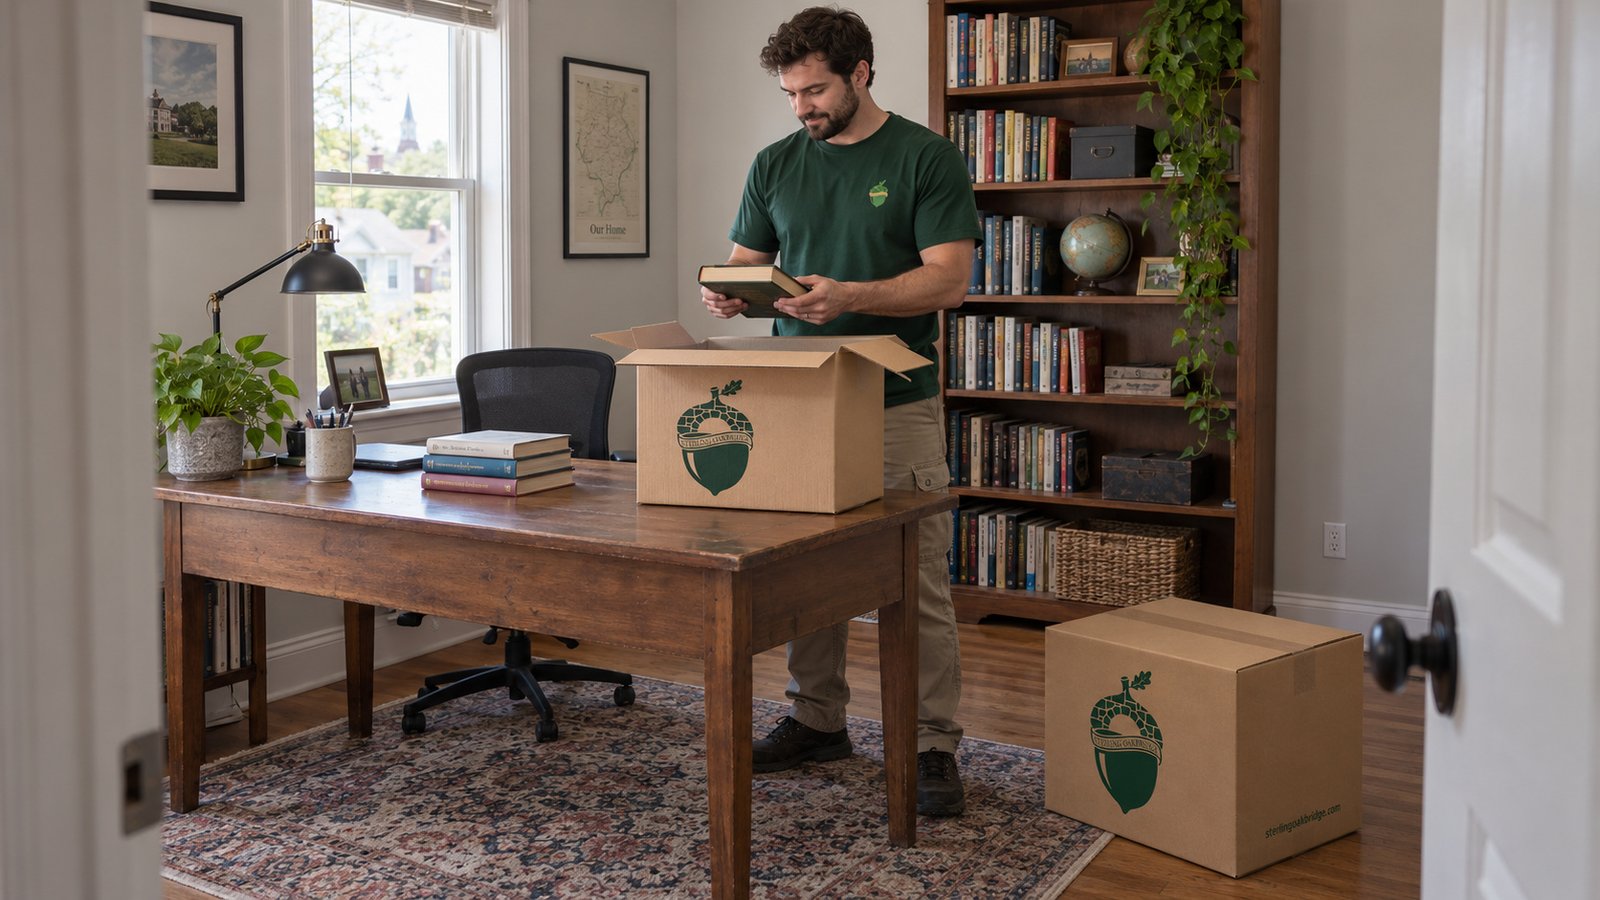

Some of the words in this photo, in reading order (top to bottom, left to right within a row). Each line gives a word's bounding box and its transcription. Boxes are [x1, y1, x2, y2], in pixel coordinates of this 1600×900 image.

[589, 223, 605, 235] Our
[605, 223, 627, 235] Home
[1265, 804, 1341, 838] sterlingoakbridge.com
